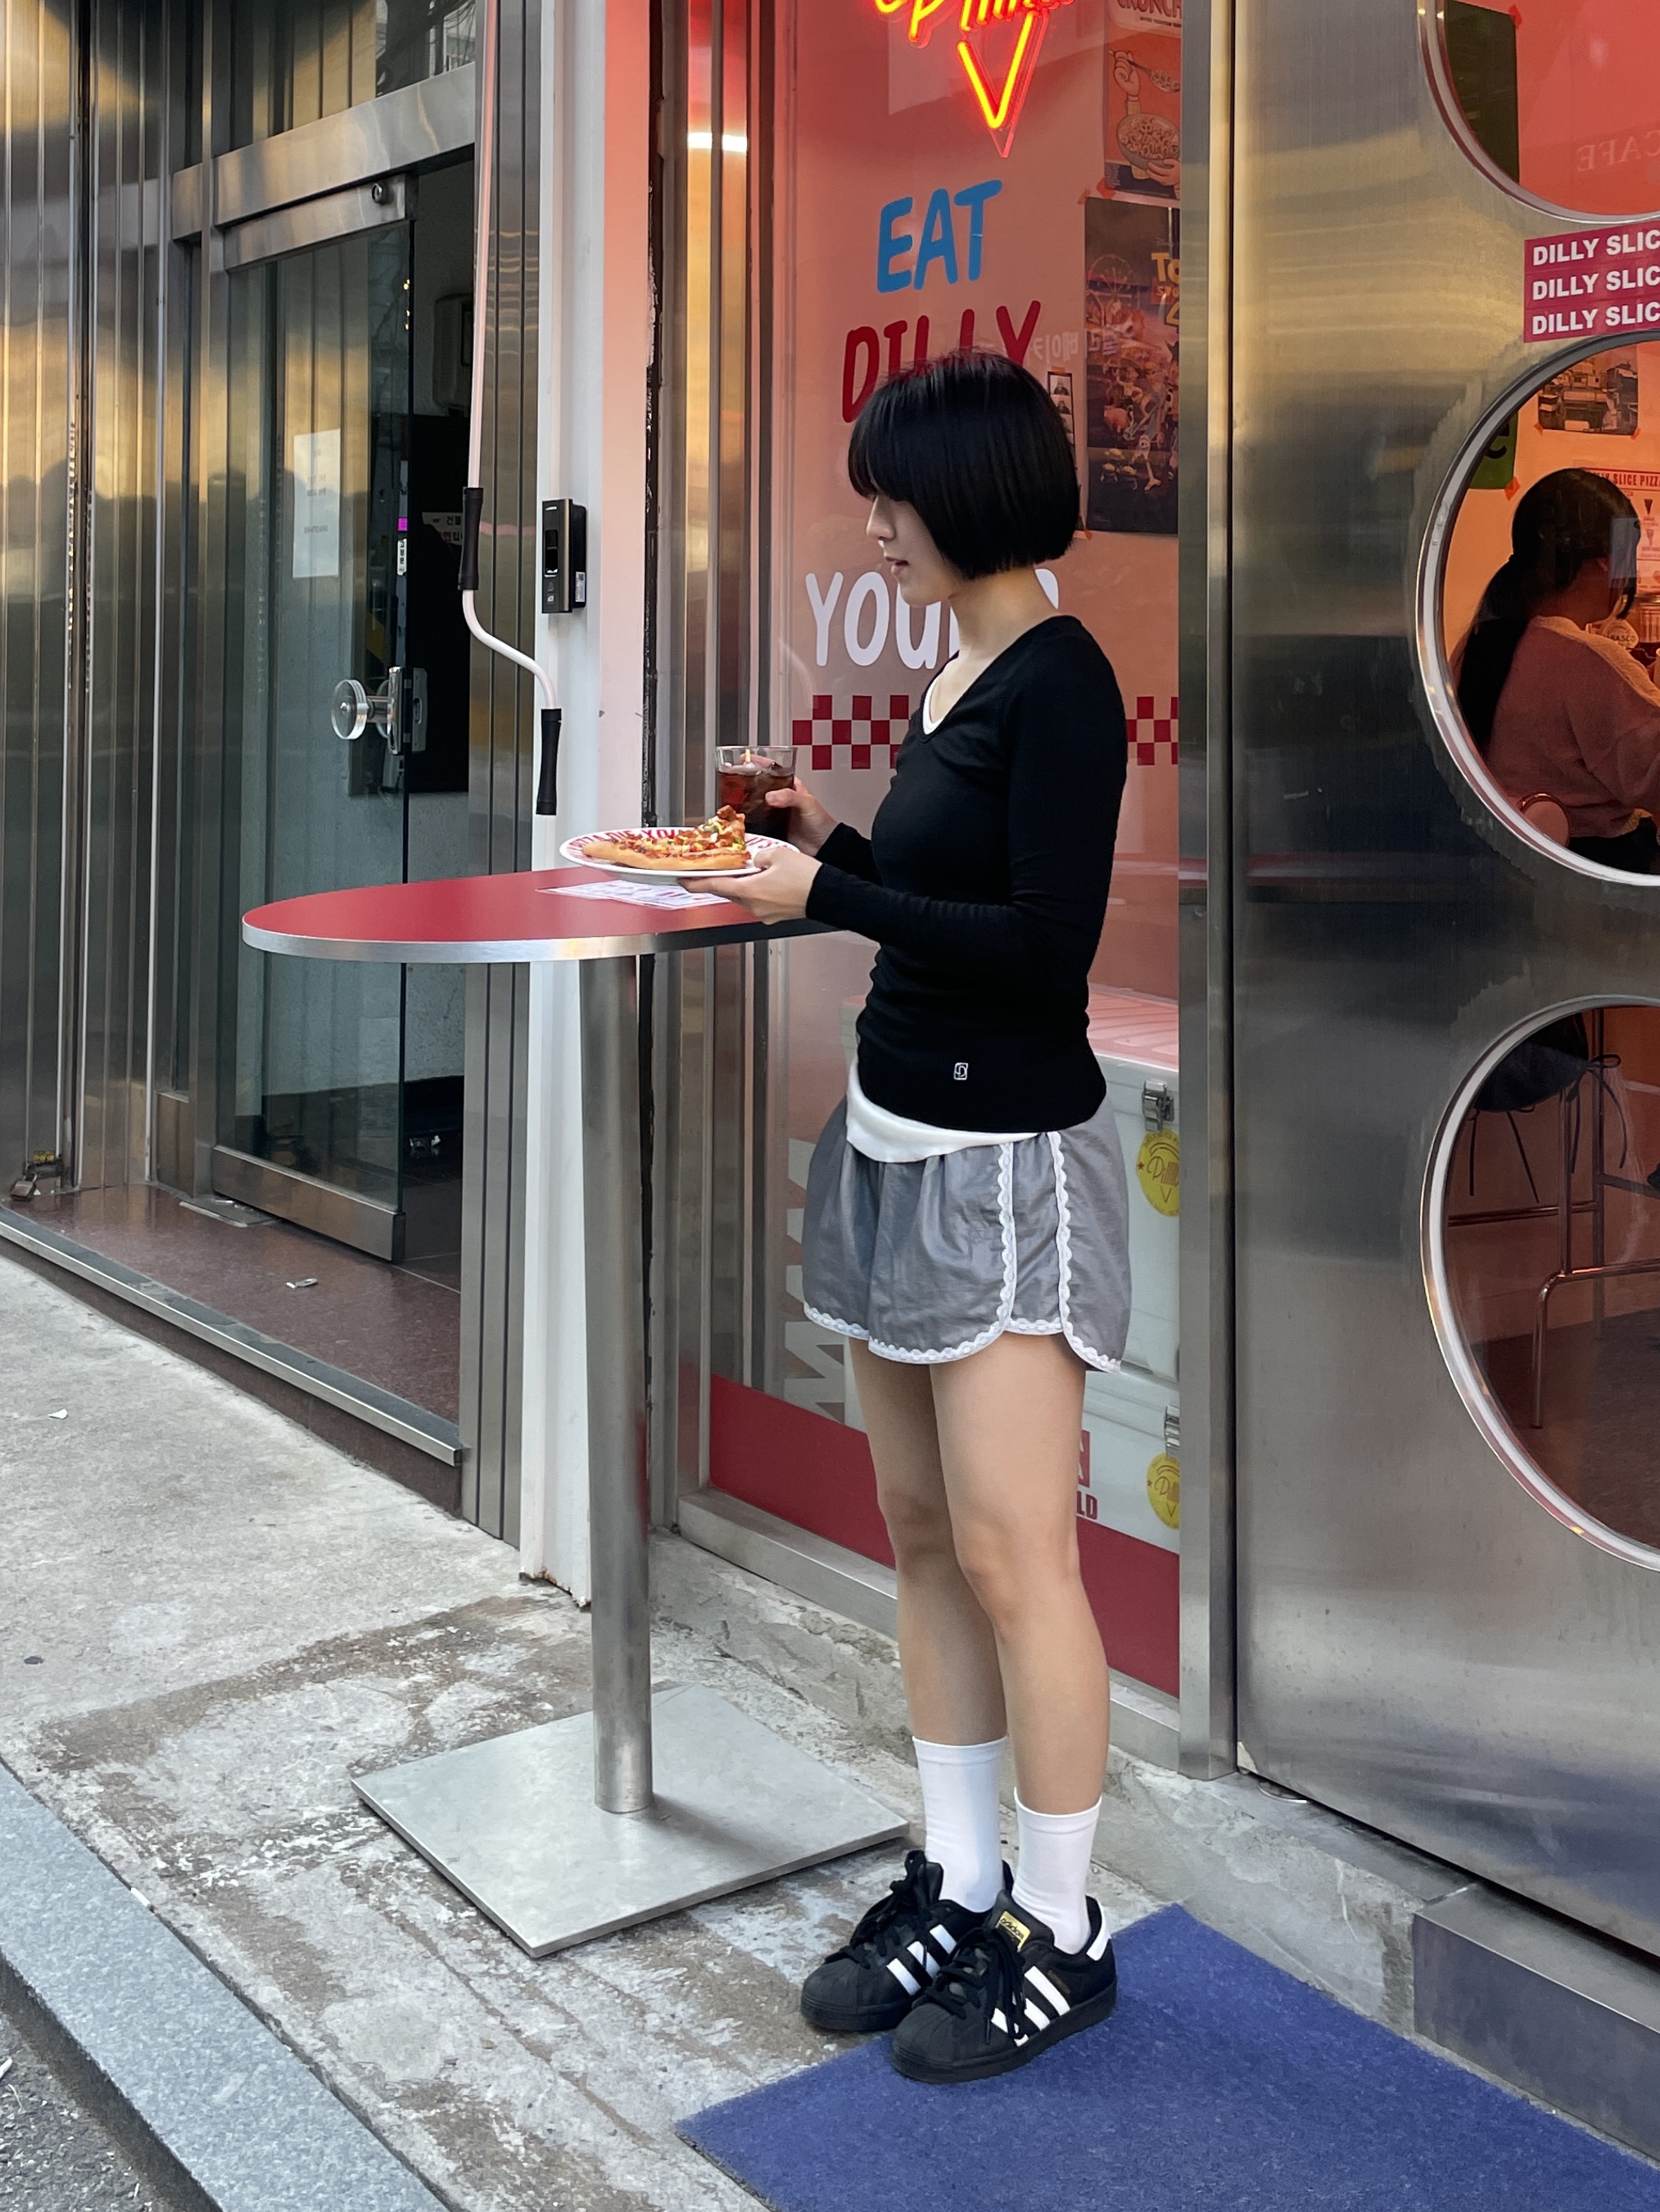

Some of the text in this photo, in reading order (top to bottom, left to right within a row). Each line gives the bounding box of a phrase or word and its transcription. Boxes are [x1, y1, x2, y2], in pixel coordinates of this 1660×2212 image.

[877, 179, 1002, 294] EAT
[1533, 229, 1660, 267] DILLY SLIC
[1151, 252, 1180, 284] TO
[1532, 265, 1660, 301] DILLY SLIC
[1156, 286, 1180, 300] STO
[1532, 301, 1660, 336] DILLY SLIC
[1613, 473, 1637, 486] SLICE
[1640, 476, 1660, 487] PIZZ
